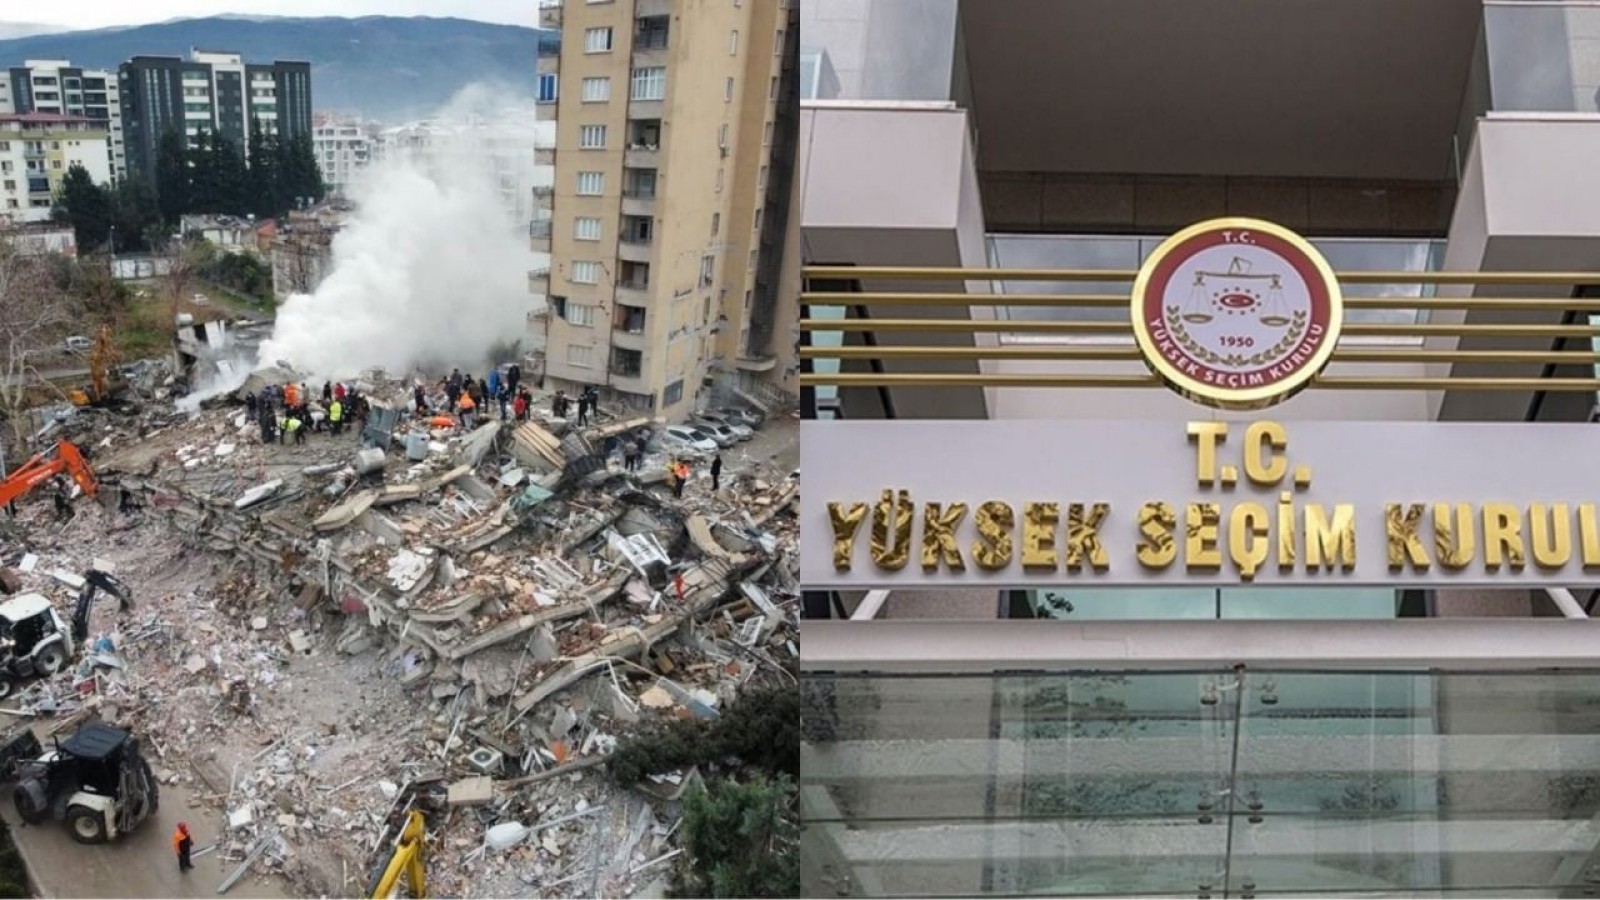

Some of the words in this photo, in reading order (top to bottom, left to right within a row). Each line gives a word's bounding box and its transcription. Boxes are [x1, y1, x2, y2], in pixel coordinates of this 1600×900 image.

[1222, 231, 1256, 244] T.C.
[1219, 335, 1255, 347] 1950
[1269, 323, 1323, 379] KURULU
[1186, 420, 1311, 490] T.C.
[827, 488, 1110, 571] YÜKSEK
[1136, 490, 1355, 581] SEÇİM
